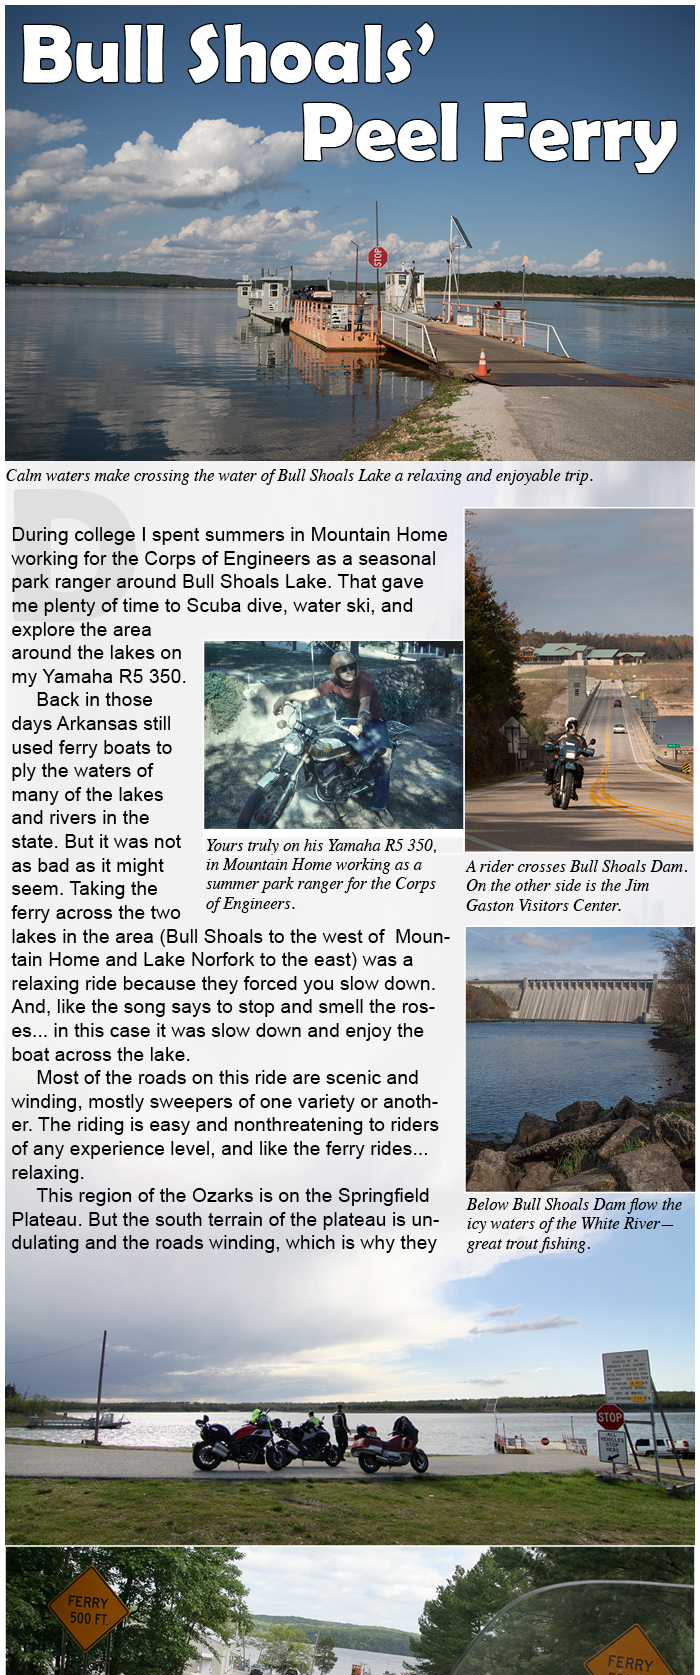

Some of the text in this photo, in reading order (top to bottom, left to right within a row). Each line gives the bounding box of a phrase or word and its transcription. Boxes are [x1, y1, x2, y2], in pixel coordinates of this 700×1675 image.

[374, 248, 382, 267] STOP
[12, 526, 448, 546] During college I spent summers in Mountain Home
[12, 668, 186, 688] my Yamaha R5 350.
[12, 975, 436, 995] relaxing ride because they forced you slow down.
[598, 1412, 622, 1423] STOP
[68, 1595, 109, 1609] FERRY
[70, 1612, 109, 1625] 500 FT.
[608, 1655, 654, 1672] FERRY
